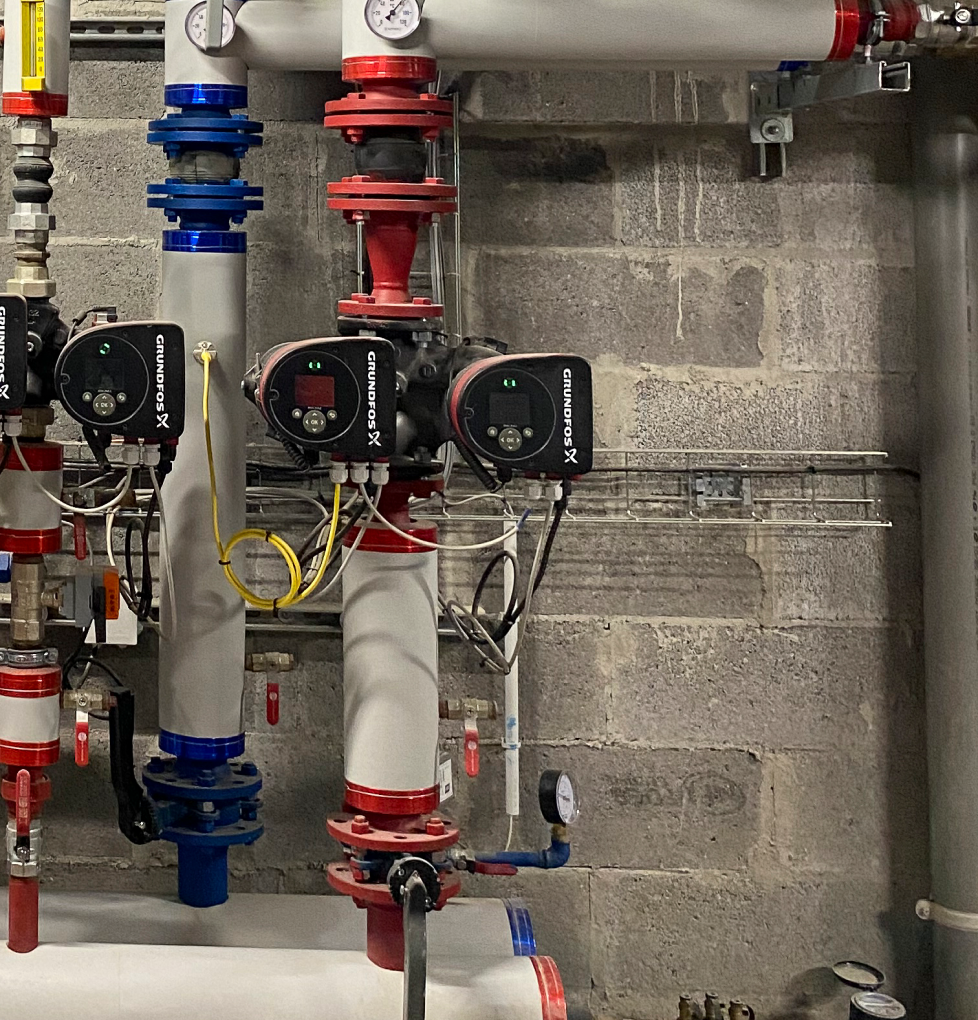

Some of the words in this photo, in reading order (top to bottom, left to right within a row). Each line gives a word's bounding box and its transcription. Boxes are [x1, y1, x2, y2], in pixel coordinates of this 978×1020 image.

[156, 333, 164, 412] GRUNDFOS
[368, 350, 376, 430] GRUNDFOS
[563, 367, 572, 447] GRUNDFOS
